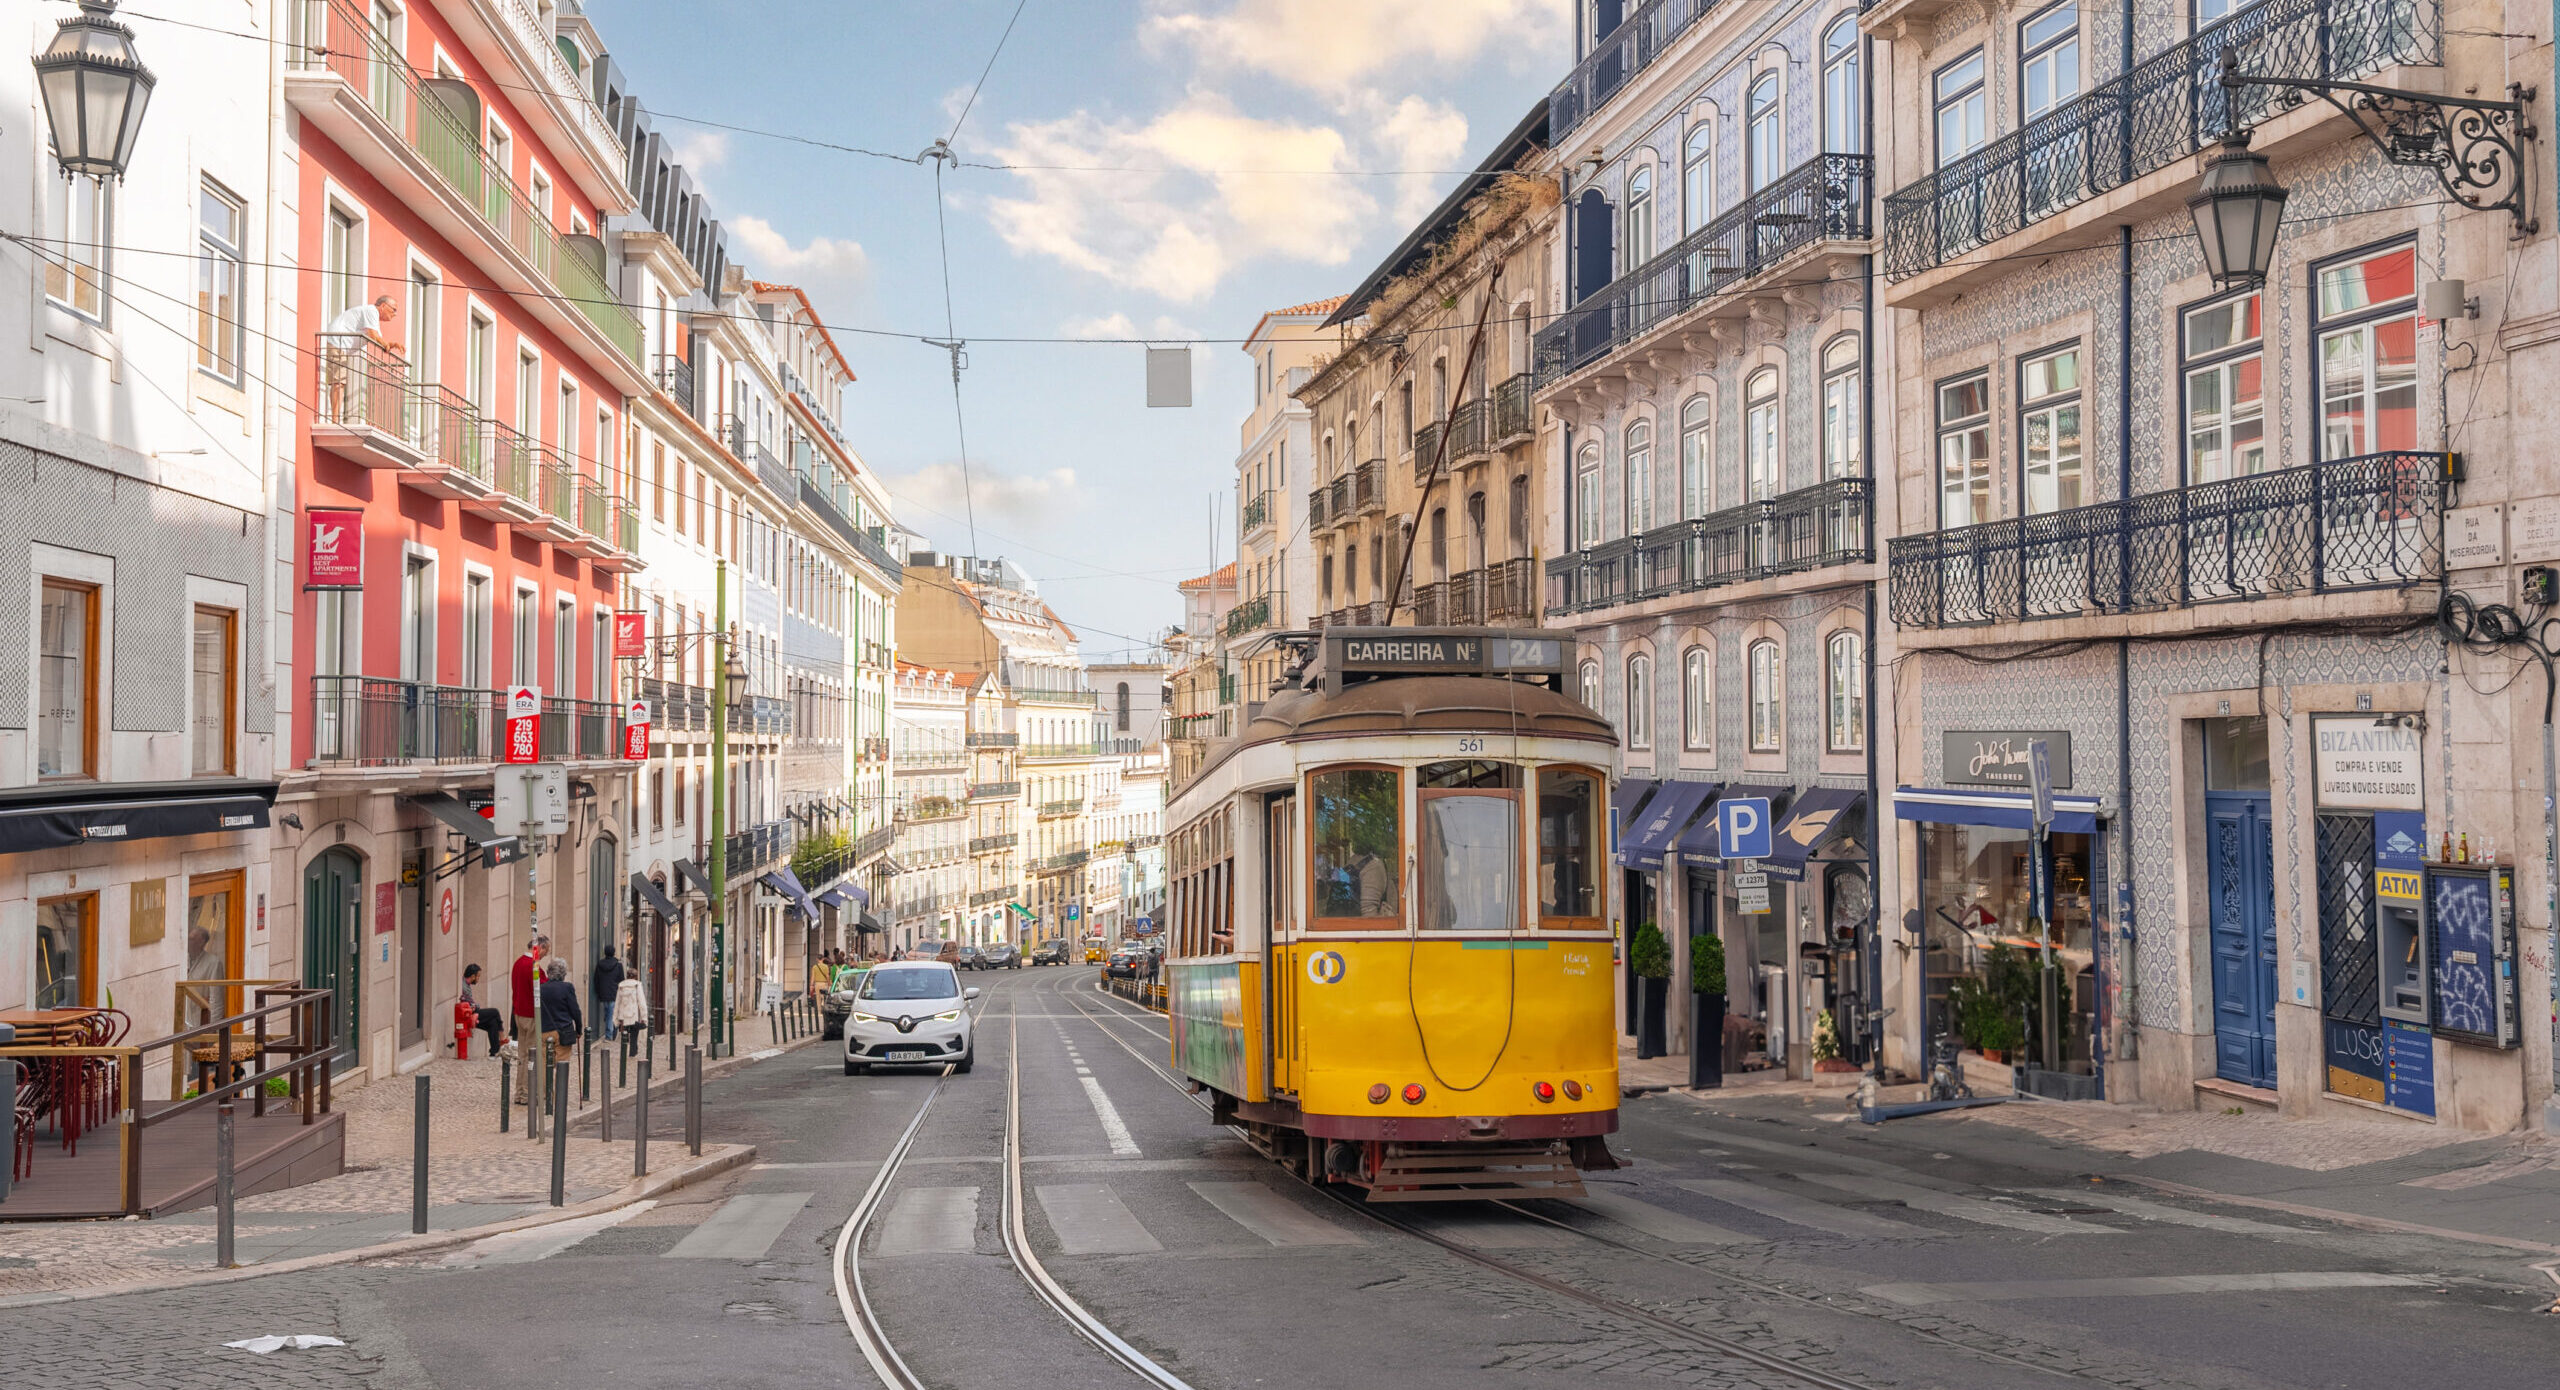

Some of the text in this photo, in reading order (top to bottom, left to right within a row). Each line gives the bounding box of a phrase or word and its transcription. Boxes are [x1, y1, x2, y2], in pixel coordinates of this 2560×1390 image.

[2465, 517, 2480, 528] RUA
[2468, 532, 2478, 542] DA
[1347, 642, 1445, 661] CARREIRA
[1509, 640, 1544, 665] 24
[516, 719, 532, 731] 219
[632, 726, 644, 735] 219
[514, 731, 534, 744] 663
[631, 736, 644, 744] 663
[2321, 731, 2418, 752] BIZANTINA
[514, 743, 533, 756] 780
[630, 744, 644, 754] 780
[1459, 738, 1484, 751] 561
[1969, 741, 2000, 776] John
[2336, 761, 2402, 774] COMPRA E VENDE
[1985, 772, 2024, 781] TAILORED
[2324, 782, 2416, 796] LIVROS NOVOS E USADOS
[88, 824, 127, 837] ESTRELLA DAMM
[1729, 805, 1759, 852] P
[2380, 876, 2418, 895] ATM
